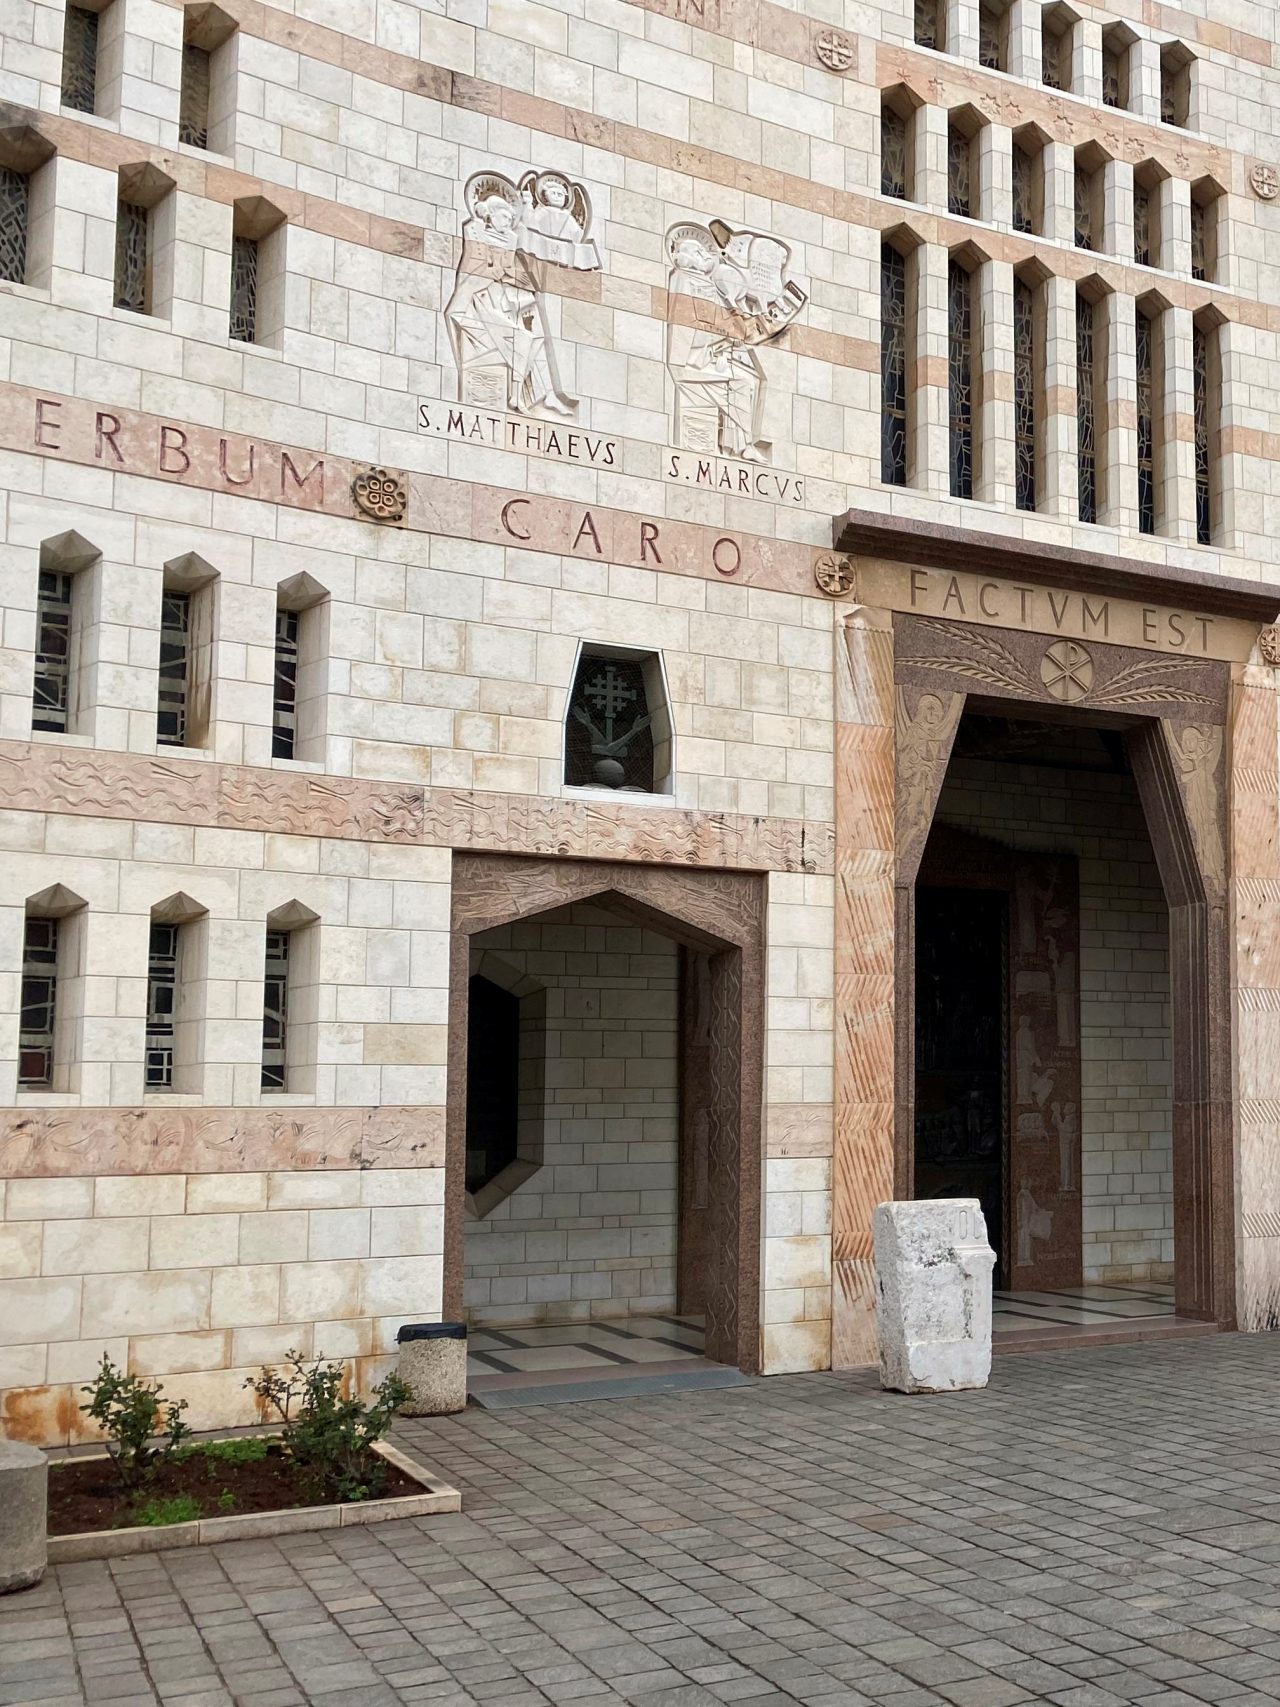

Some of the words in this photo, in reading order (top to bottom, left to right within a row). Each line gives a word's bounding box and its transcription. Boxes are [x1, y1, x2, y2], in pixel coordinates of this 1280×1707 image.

[34, 398, 325, 505] ERBUM
[500, 498, 742, 577] CARO
[909, 569, 1110, 637] FACTVM
[1142, 607, 1215, 652] EST
